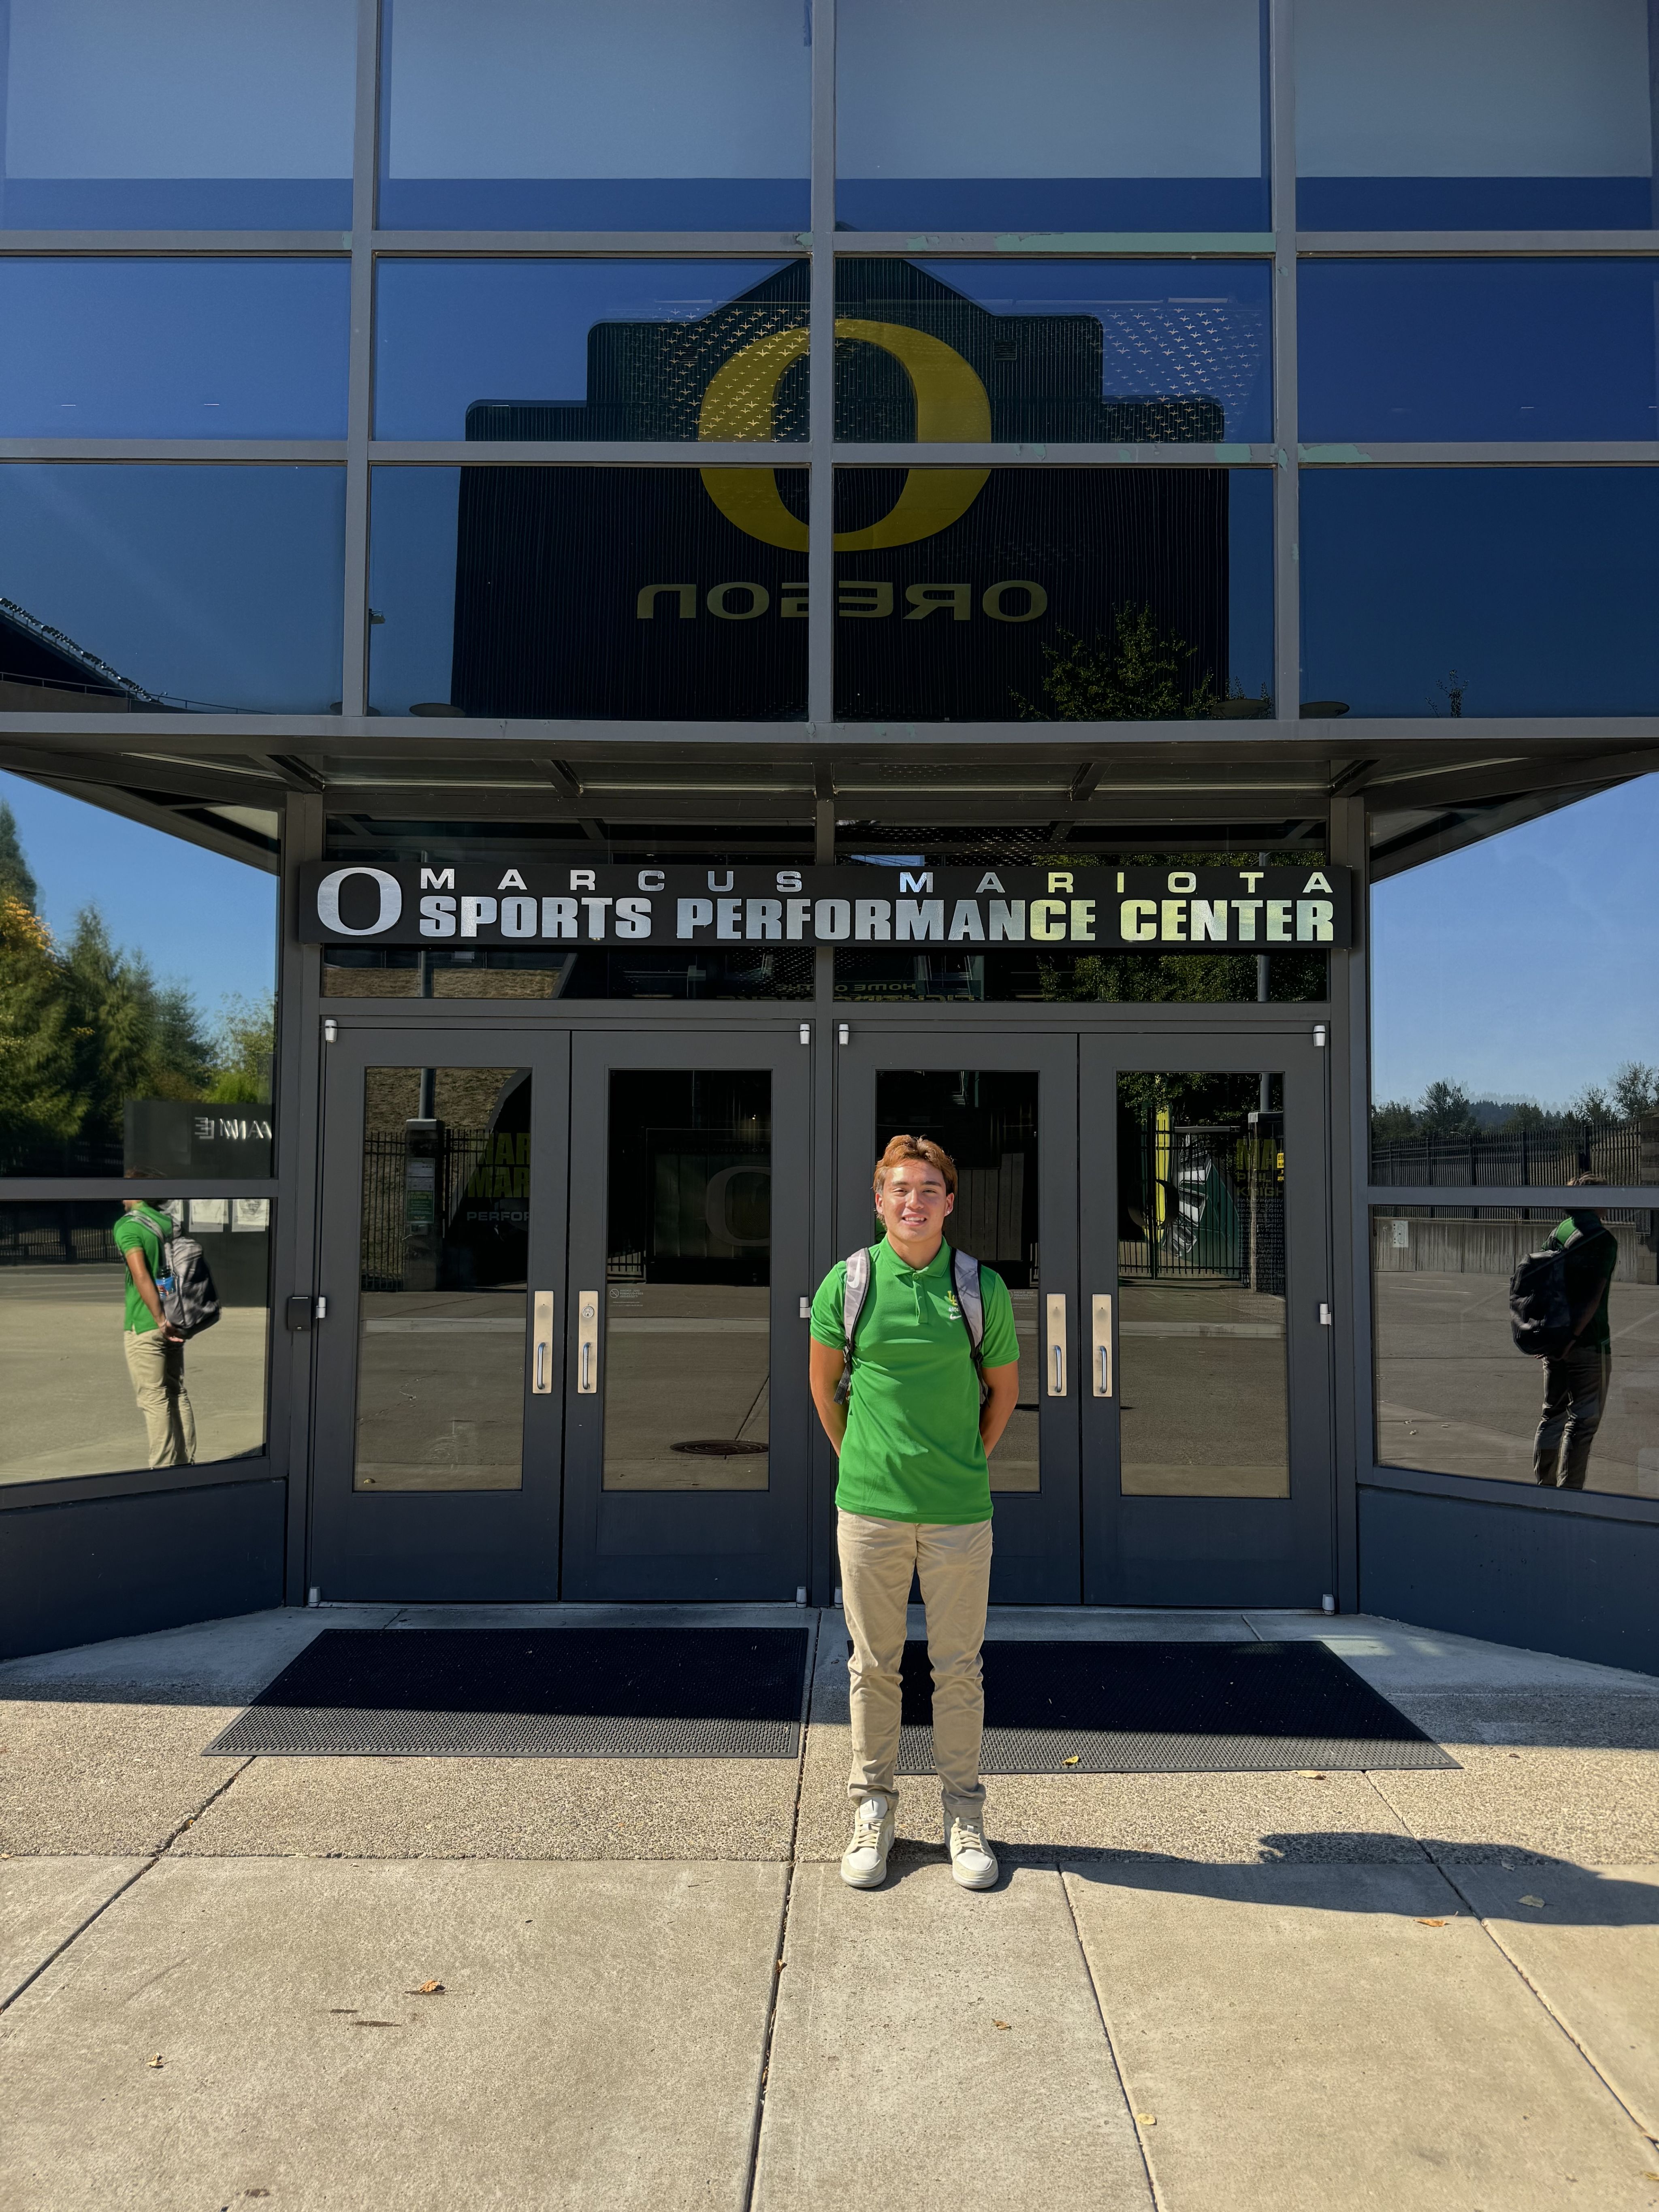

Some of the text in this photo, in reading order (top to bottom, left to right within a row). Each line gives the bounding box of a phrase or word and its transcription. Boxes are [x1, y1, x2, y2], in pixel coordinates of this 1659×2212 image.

[318, 867, 401, 936] O
[420, 868, 1333, 893] MARCUS MARIOTA
[420, 896, 1333, 942] SPORTS PERFORMANCE CENTER
